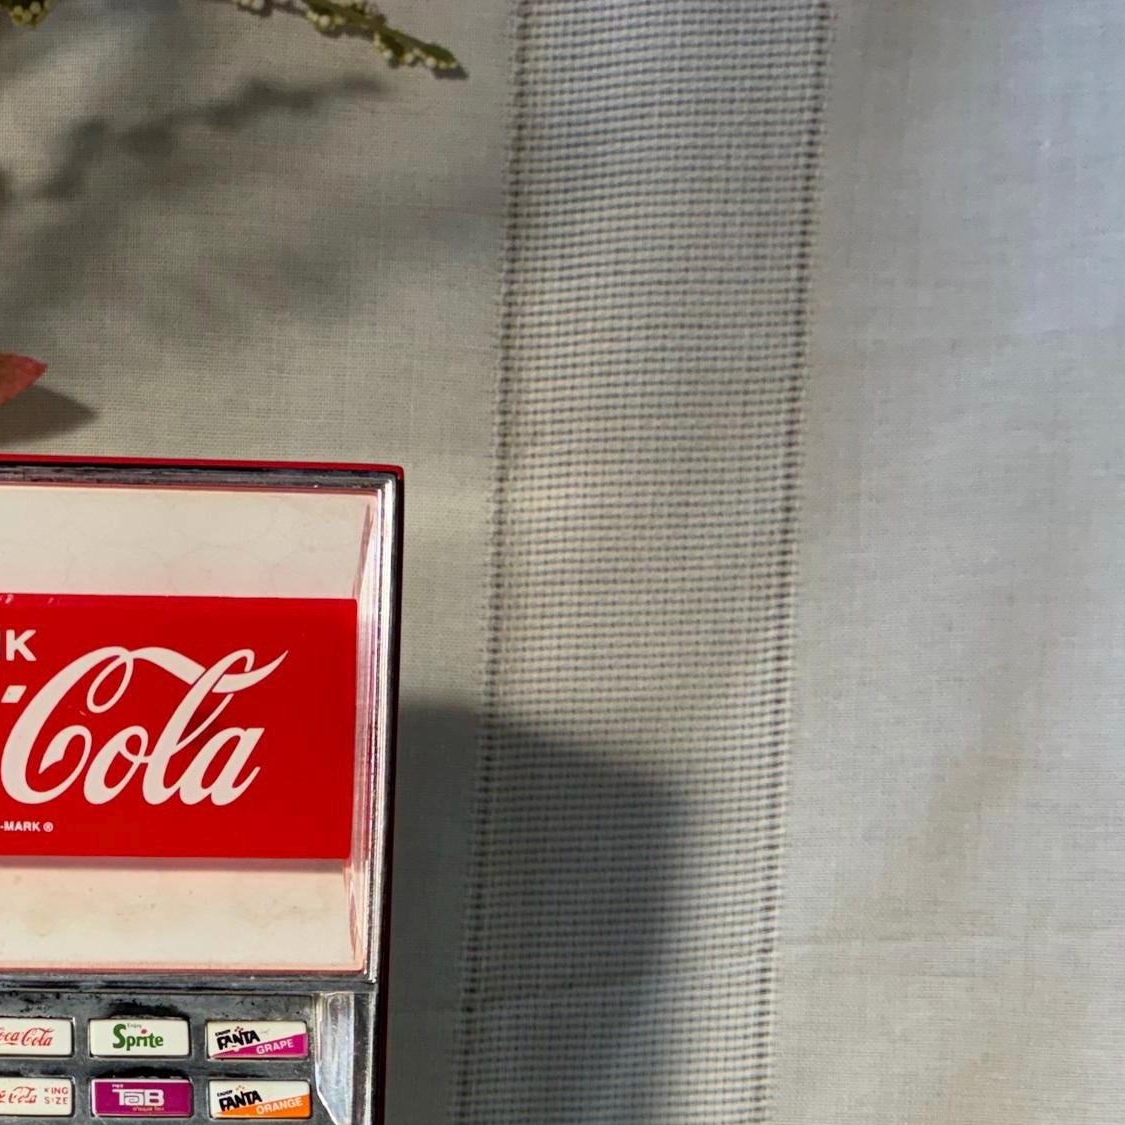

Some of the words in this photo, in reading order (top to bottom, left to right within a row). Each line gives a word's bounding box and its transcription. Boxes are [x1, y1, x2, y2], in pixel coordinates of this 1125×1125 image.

[112, 1023, 164, 1051] Sprite
[216, 1030, 261, 1050] FANTA
[256, 1038, 295, 1055] GRAPE
[218, 1090, 263, 1112] FANTA
[256, 1096, 304, 1115] ORANGE
